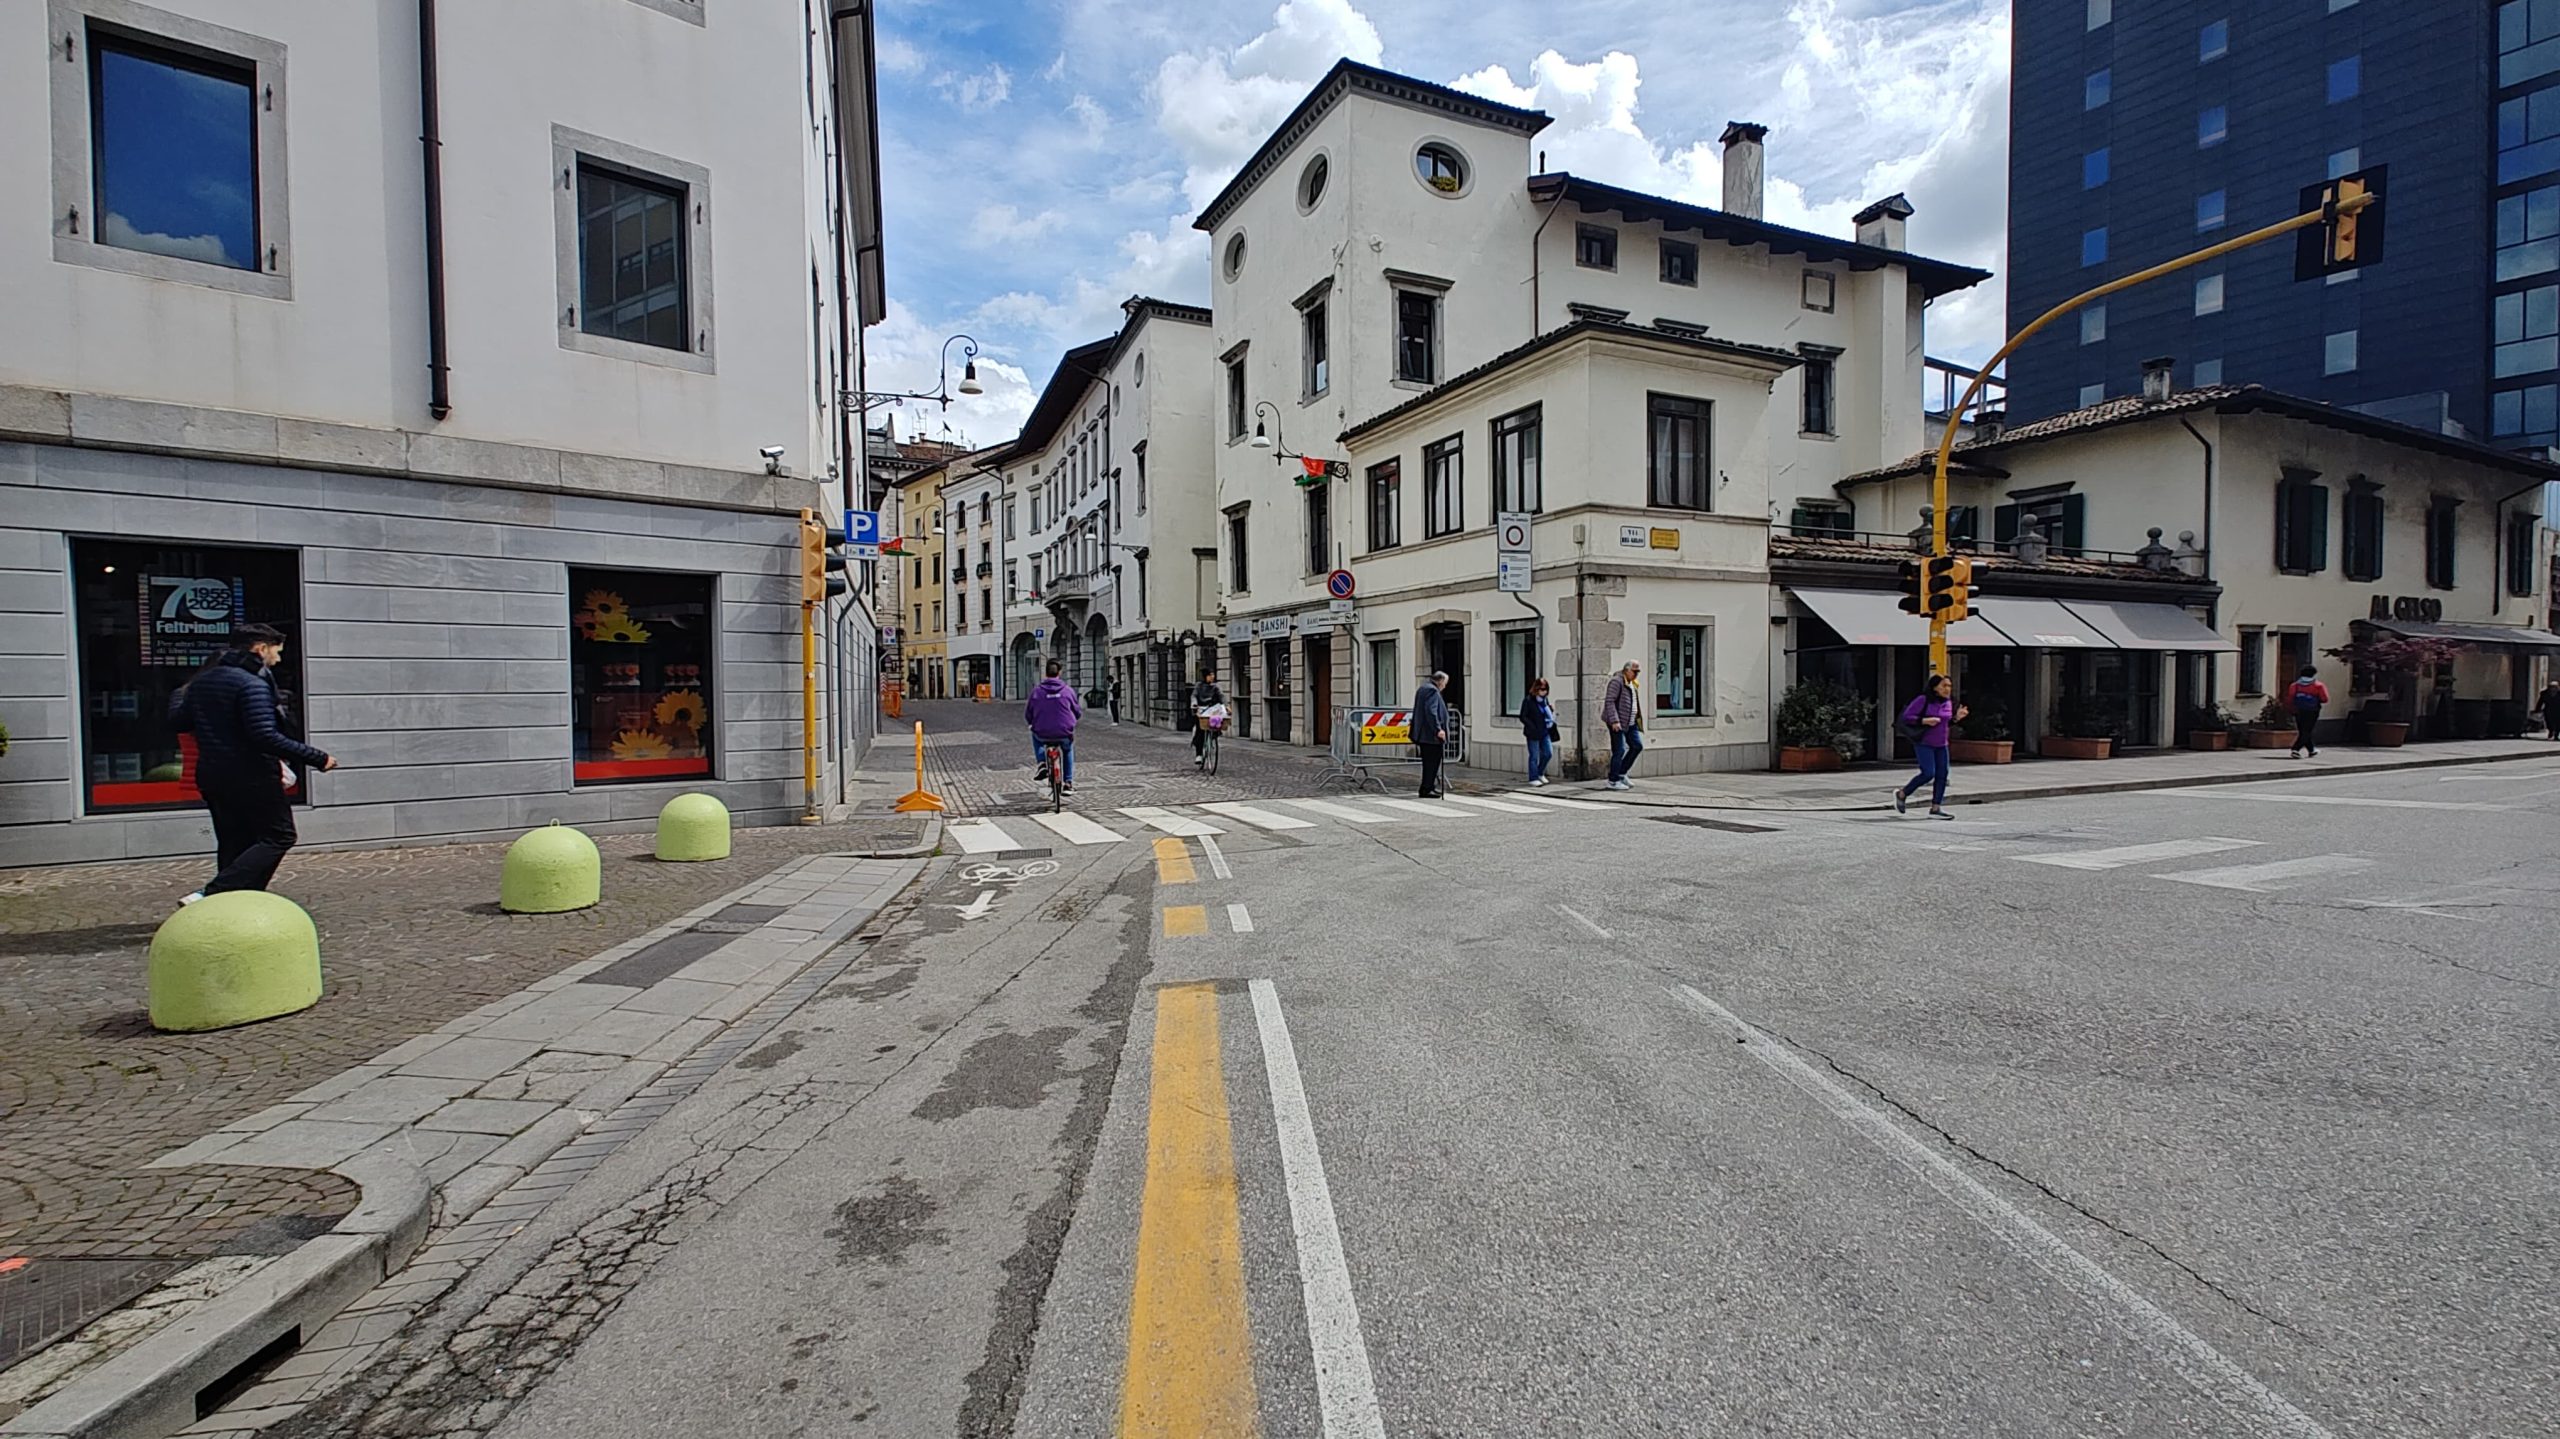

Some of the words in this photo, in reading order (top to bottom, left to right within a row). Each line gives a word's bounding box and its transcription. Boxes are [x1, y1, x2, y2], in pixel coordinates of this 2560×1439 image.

[851, 513, 873, 540] P
[150, 577, 232, 619] 70
[190, 587, 230, 599] 1955
[187, 598, 231, 610] 2025
[156, 620, 230, 634] Feltrinelli
[1261, 617, 1288, 632] BANSHI
